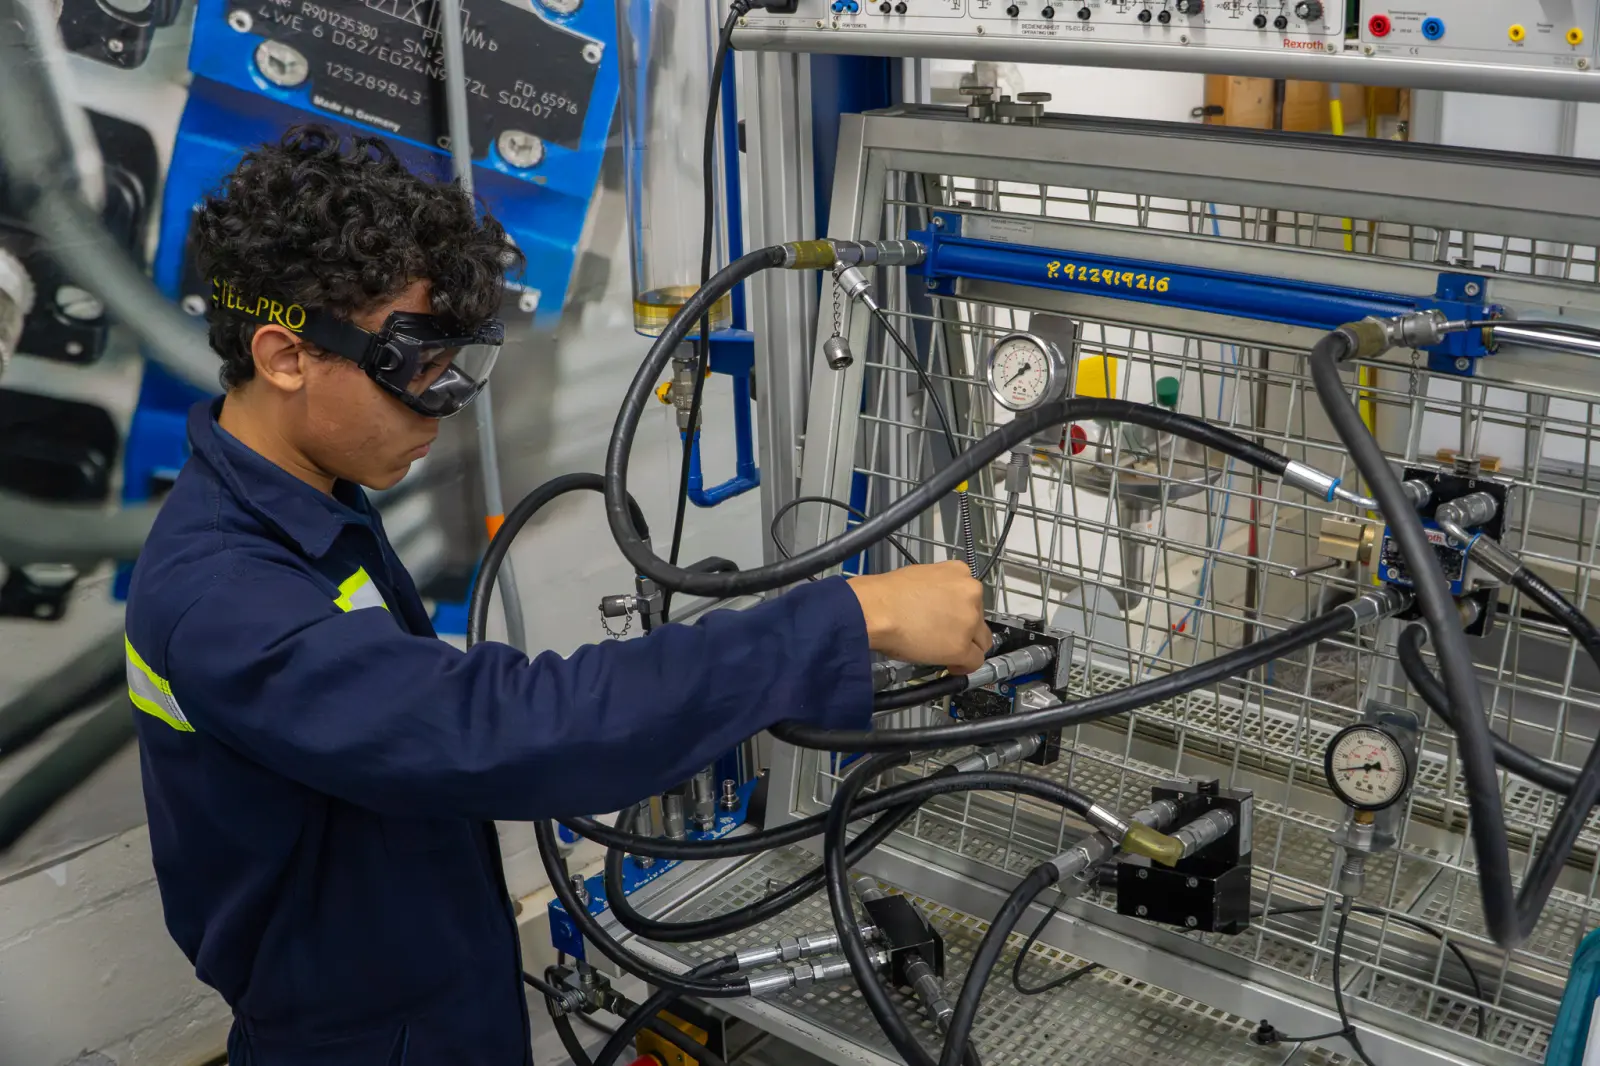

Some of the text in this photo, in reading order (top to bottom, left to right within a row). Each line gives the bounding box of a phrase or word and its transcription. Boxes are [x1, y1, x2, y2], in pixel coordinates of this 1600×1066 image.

[1283, 38, 1324, 50] Rexroth
[301, 2, 378, 40] R901235380
[403, 38, 432, 58] SN:
[514, 80, 537, 97] FD:
[326, 62, 422, 106] 125289843
[313, 95, 401, 133] Made in Germany
[1003, 626, 1010, 635] A
[1029, 632, 1035, 641] B
[1177, 792, 1184, 800] P
[1206, 796, 1213, 805] T
